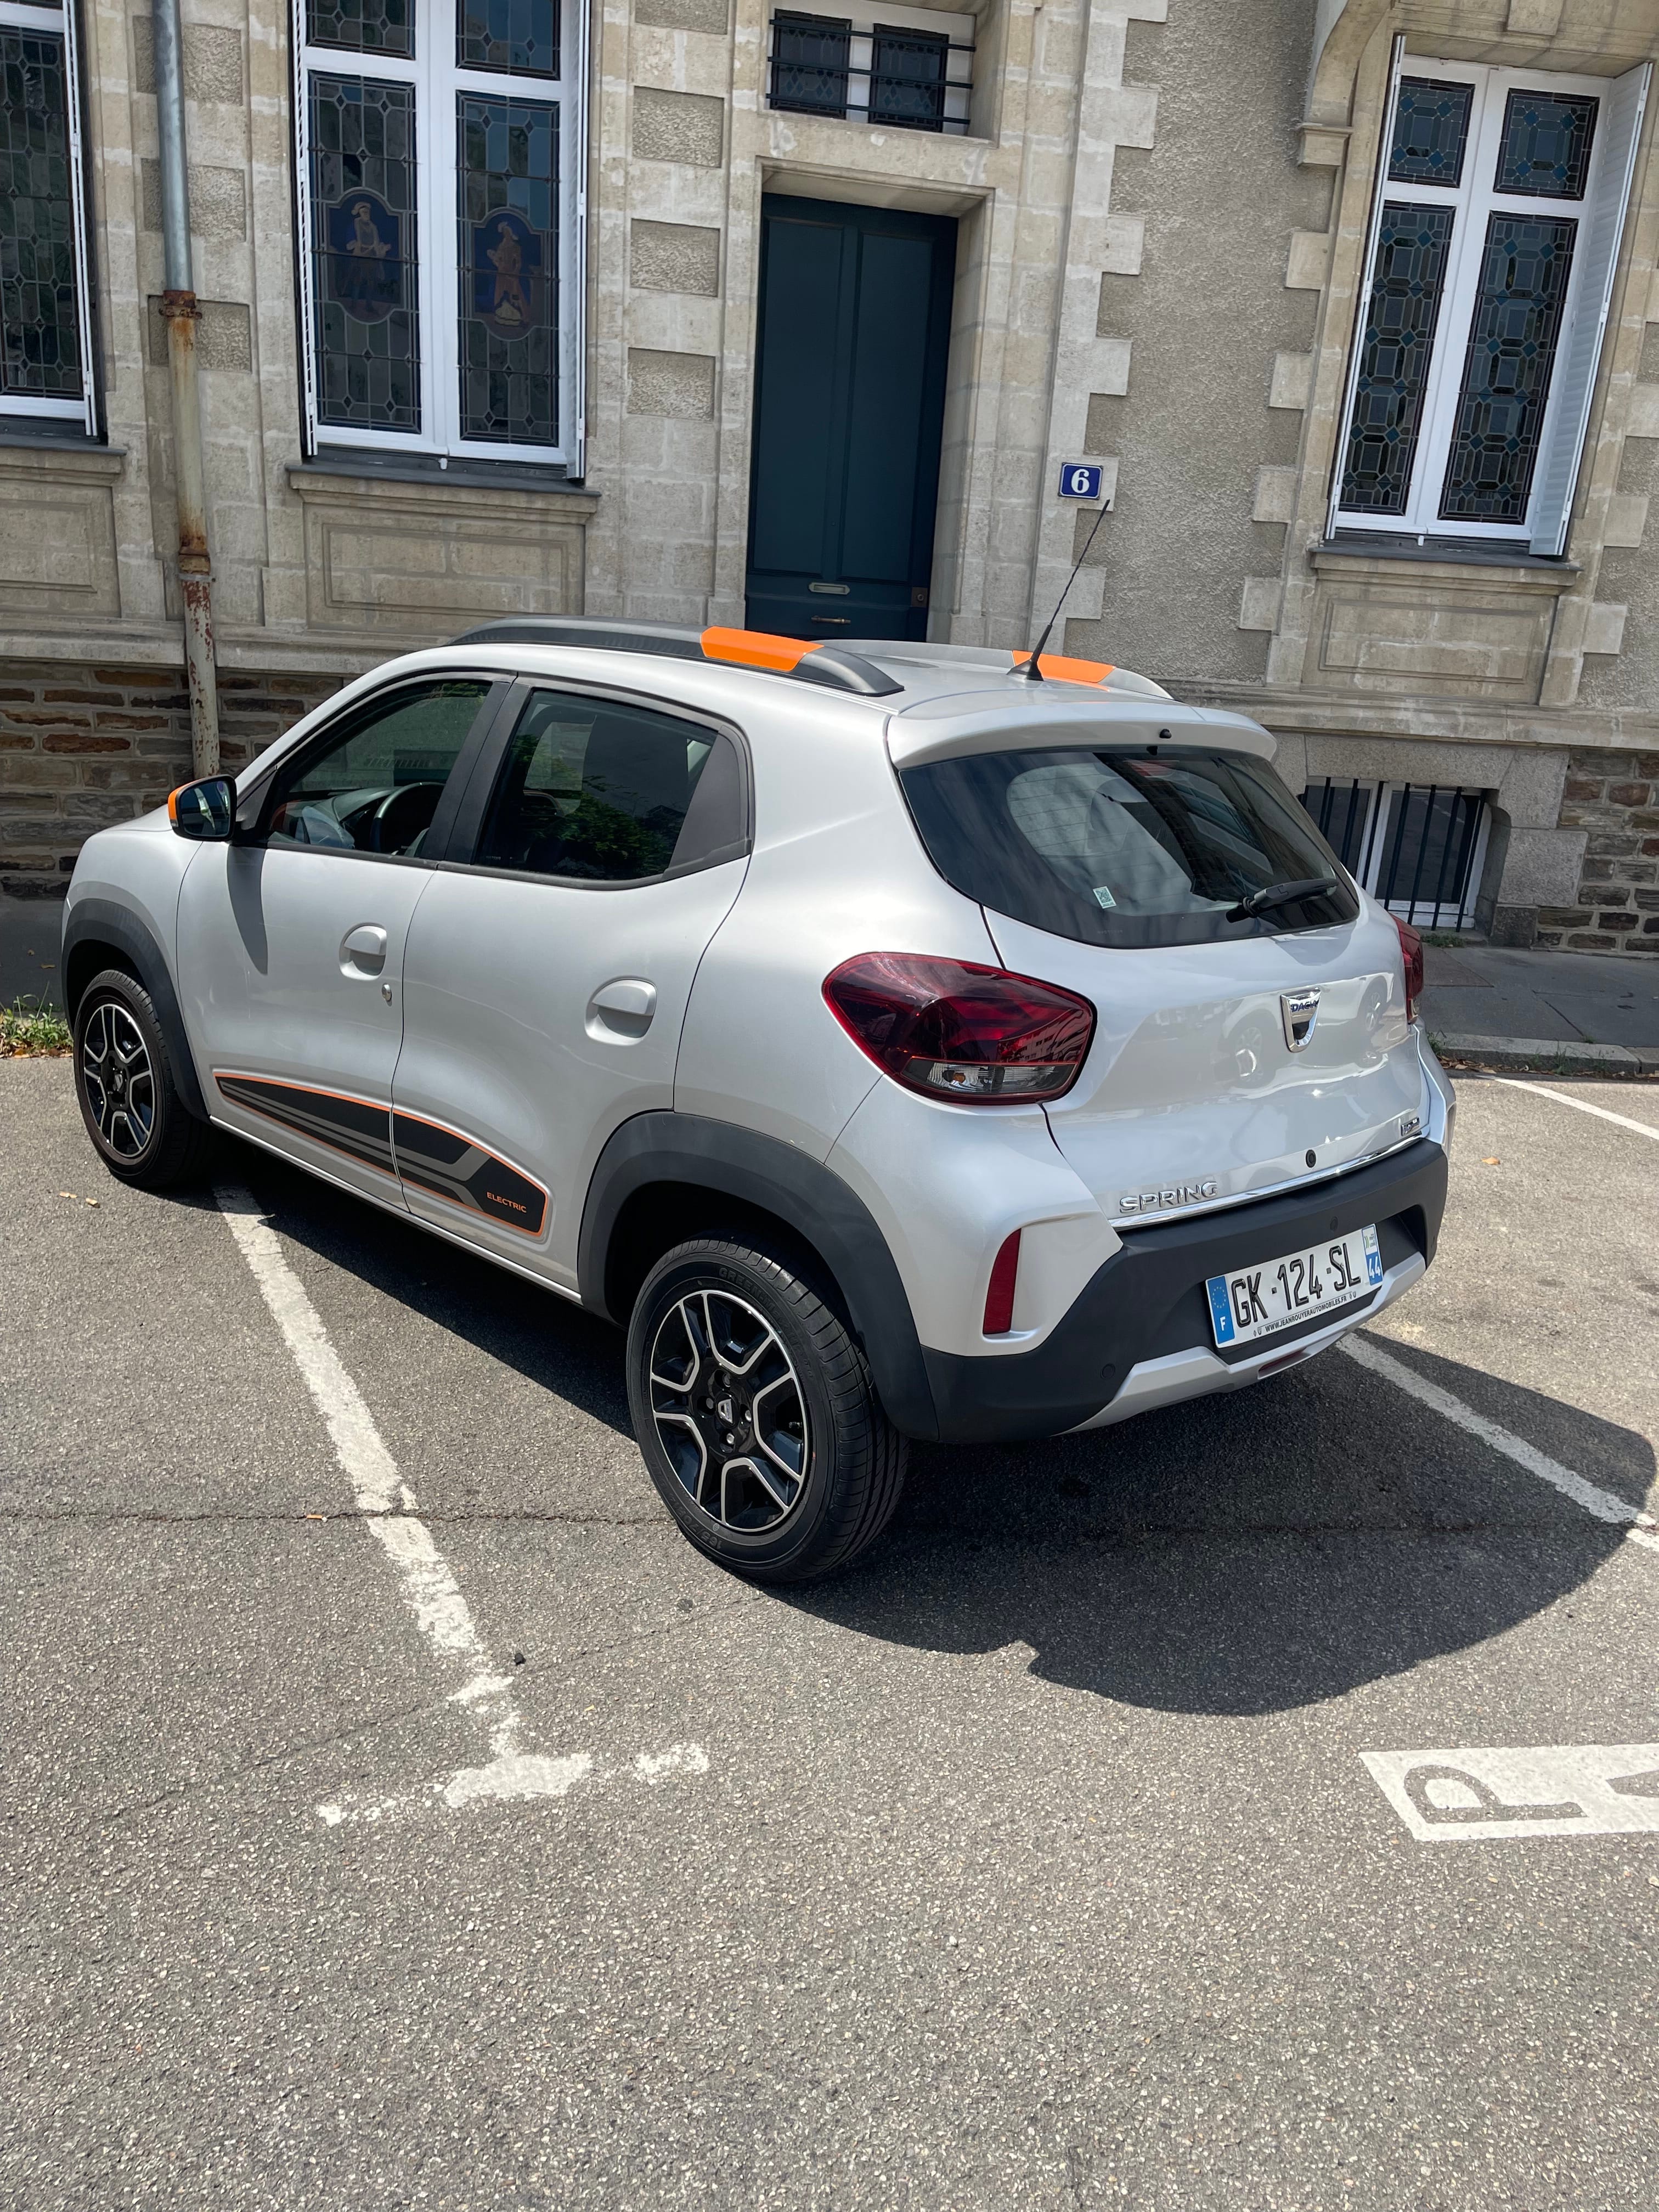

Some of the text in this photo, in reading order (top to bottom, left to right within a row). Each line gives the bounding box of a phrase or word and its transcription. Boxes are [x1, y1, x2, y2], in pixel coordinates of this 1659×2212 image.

[1071, 469, 1090, 493] 6
[487, 1192, 527, 1212] ELECTRIC
[1120, 1181, 1218, 1213] SPRING
[1369, 1256, 1381, 1278] 44
[1220, 1317, 1226, 1331] F
[1265, 1295, 1347, 1332] WWW.JEANROUYERAUTOMOBILES.FR
